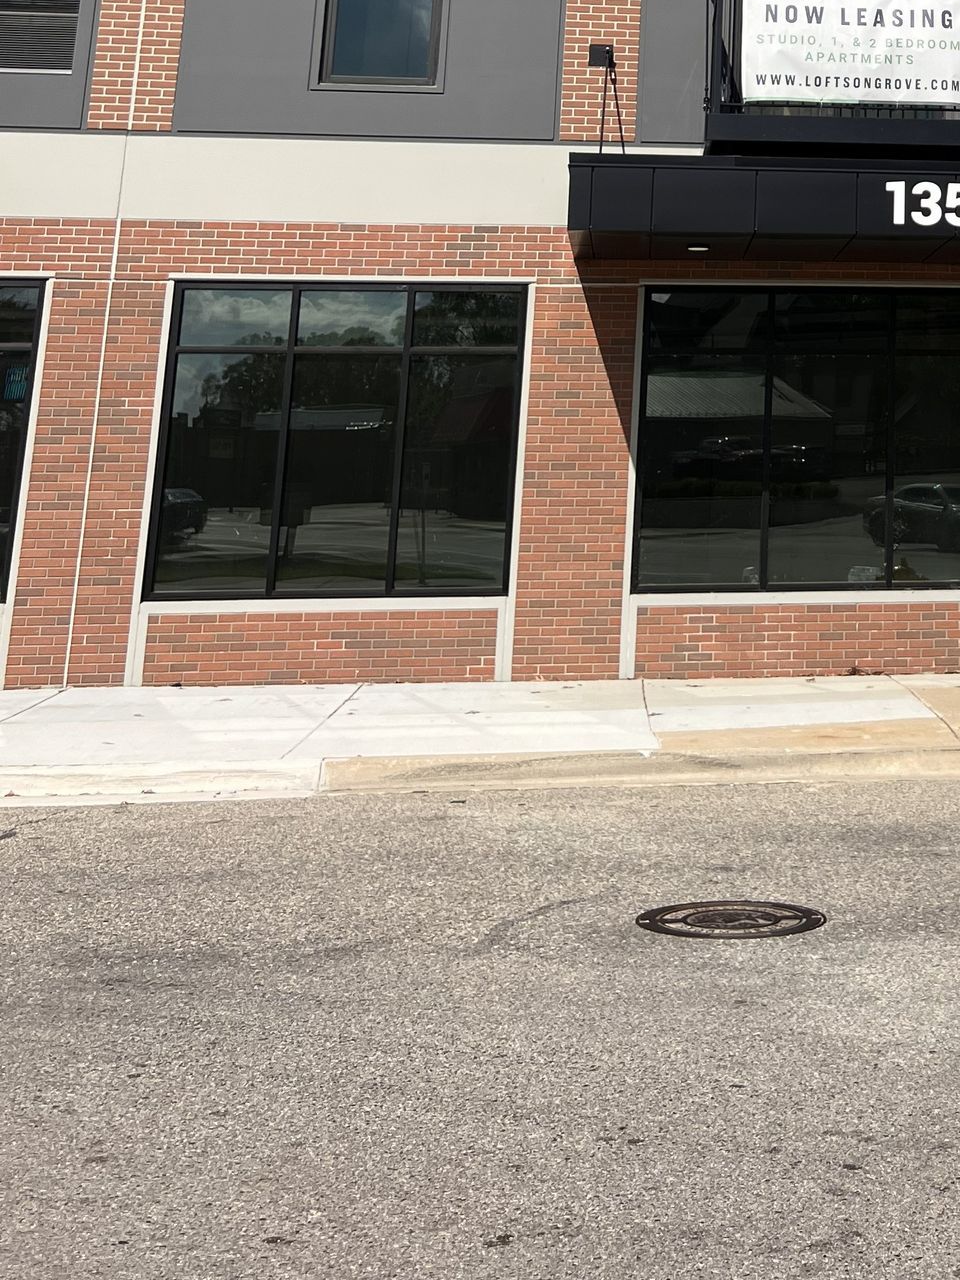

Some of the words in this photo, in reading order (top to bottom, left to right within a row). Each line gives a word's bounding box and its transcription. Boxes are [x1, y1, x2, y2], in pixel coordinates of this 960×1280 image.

[765, 4, 825, 24] NOW
[840, 7, 954, 29] LEASING
[756, 33, 823, 48] STUDIO,
[831, 36, 845, 48] 1,
[852, 37, 861, 47] &
[869, 38, 877, 48] 2
[885, 37, 960, 51] BEDROOM
[804, 52, 915, 65] APARTMENTS
[755, 73, 960, 92] WWW.LOFTSONGROVE.COM
